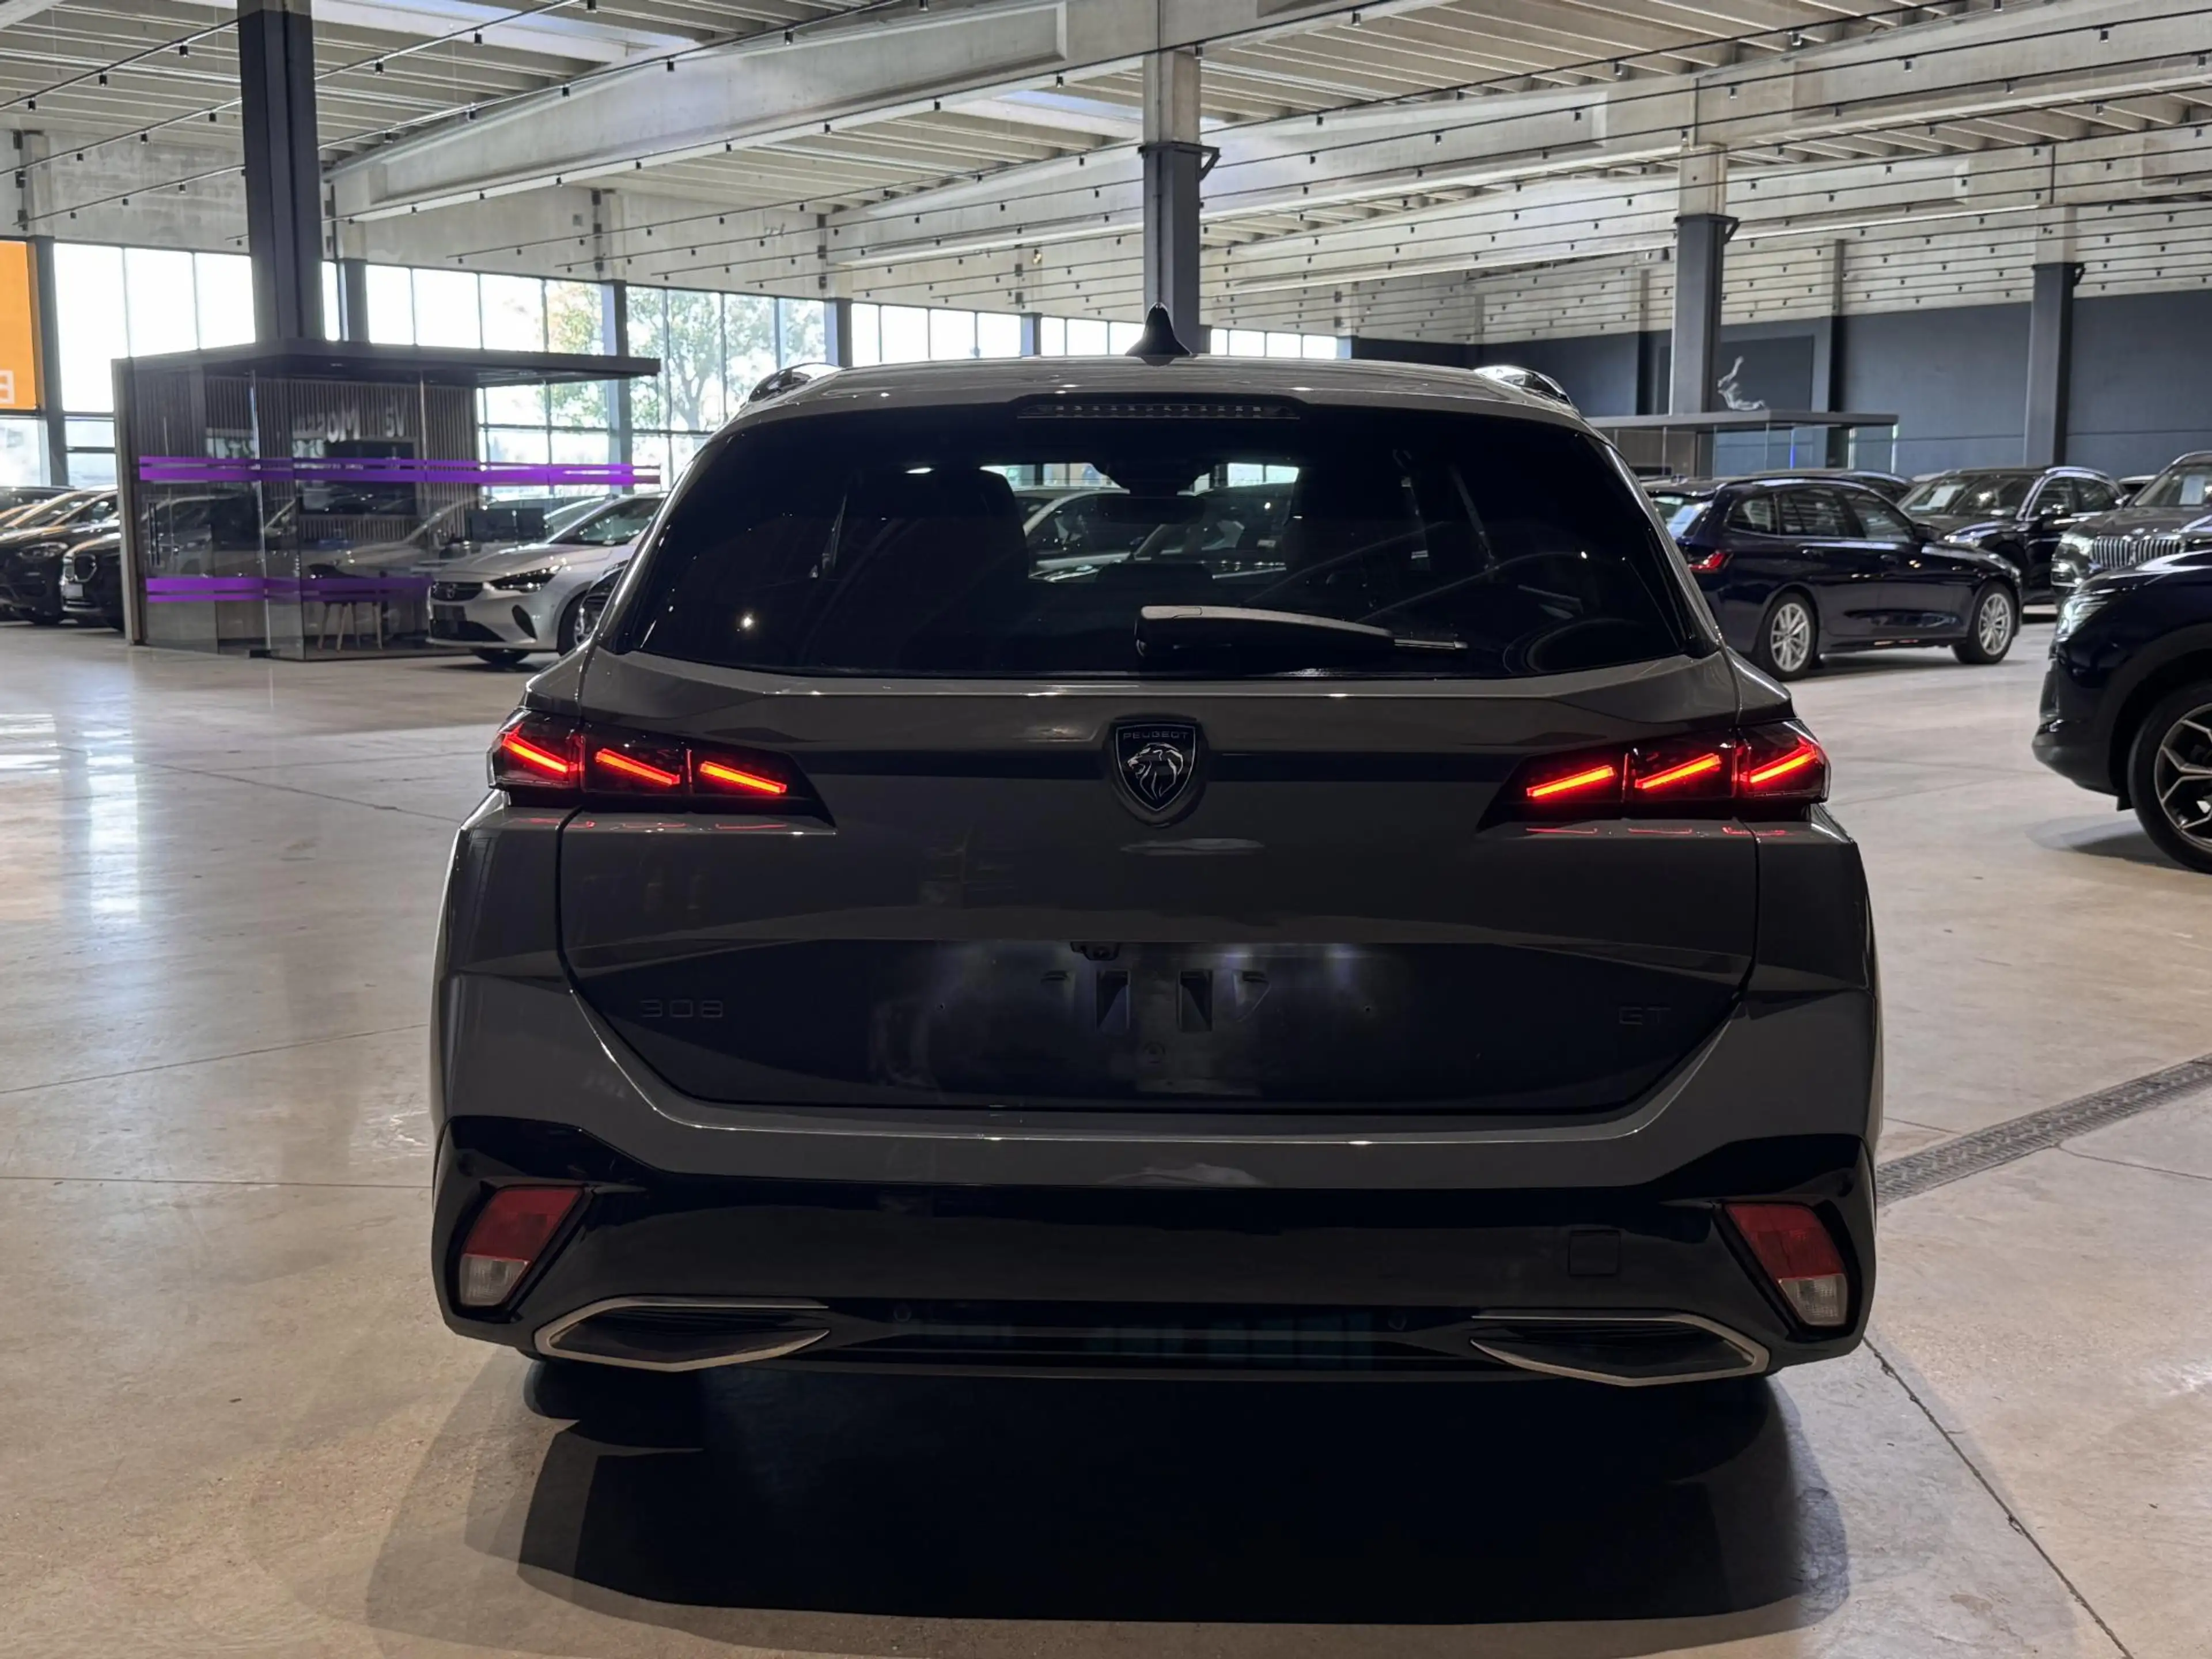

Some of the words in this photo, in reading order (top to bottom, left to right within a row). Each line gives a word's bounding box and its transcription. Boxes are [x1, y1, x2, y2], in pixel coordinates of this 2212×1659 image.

[1123, 730, 1190, 741] PEUGEOT
[639, 999, 724, 1018] 308
[1618, 1006, 1672, 1026] GT
